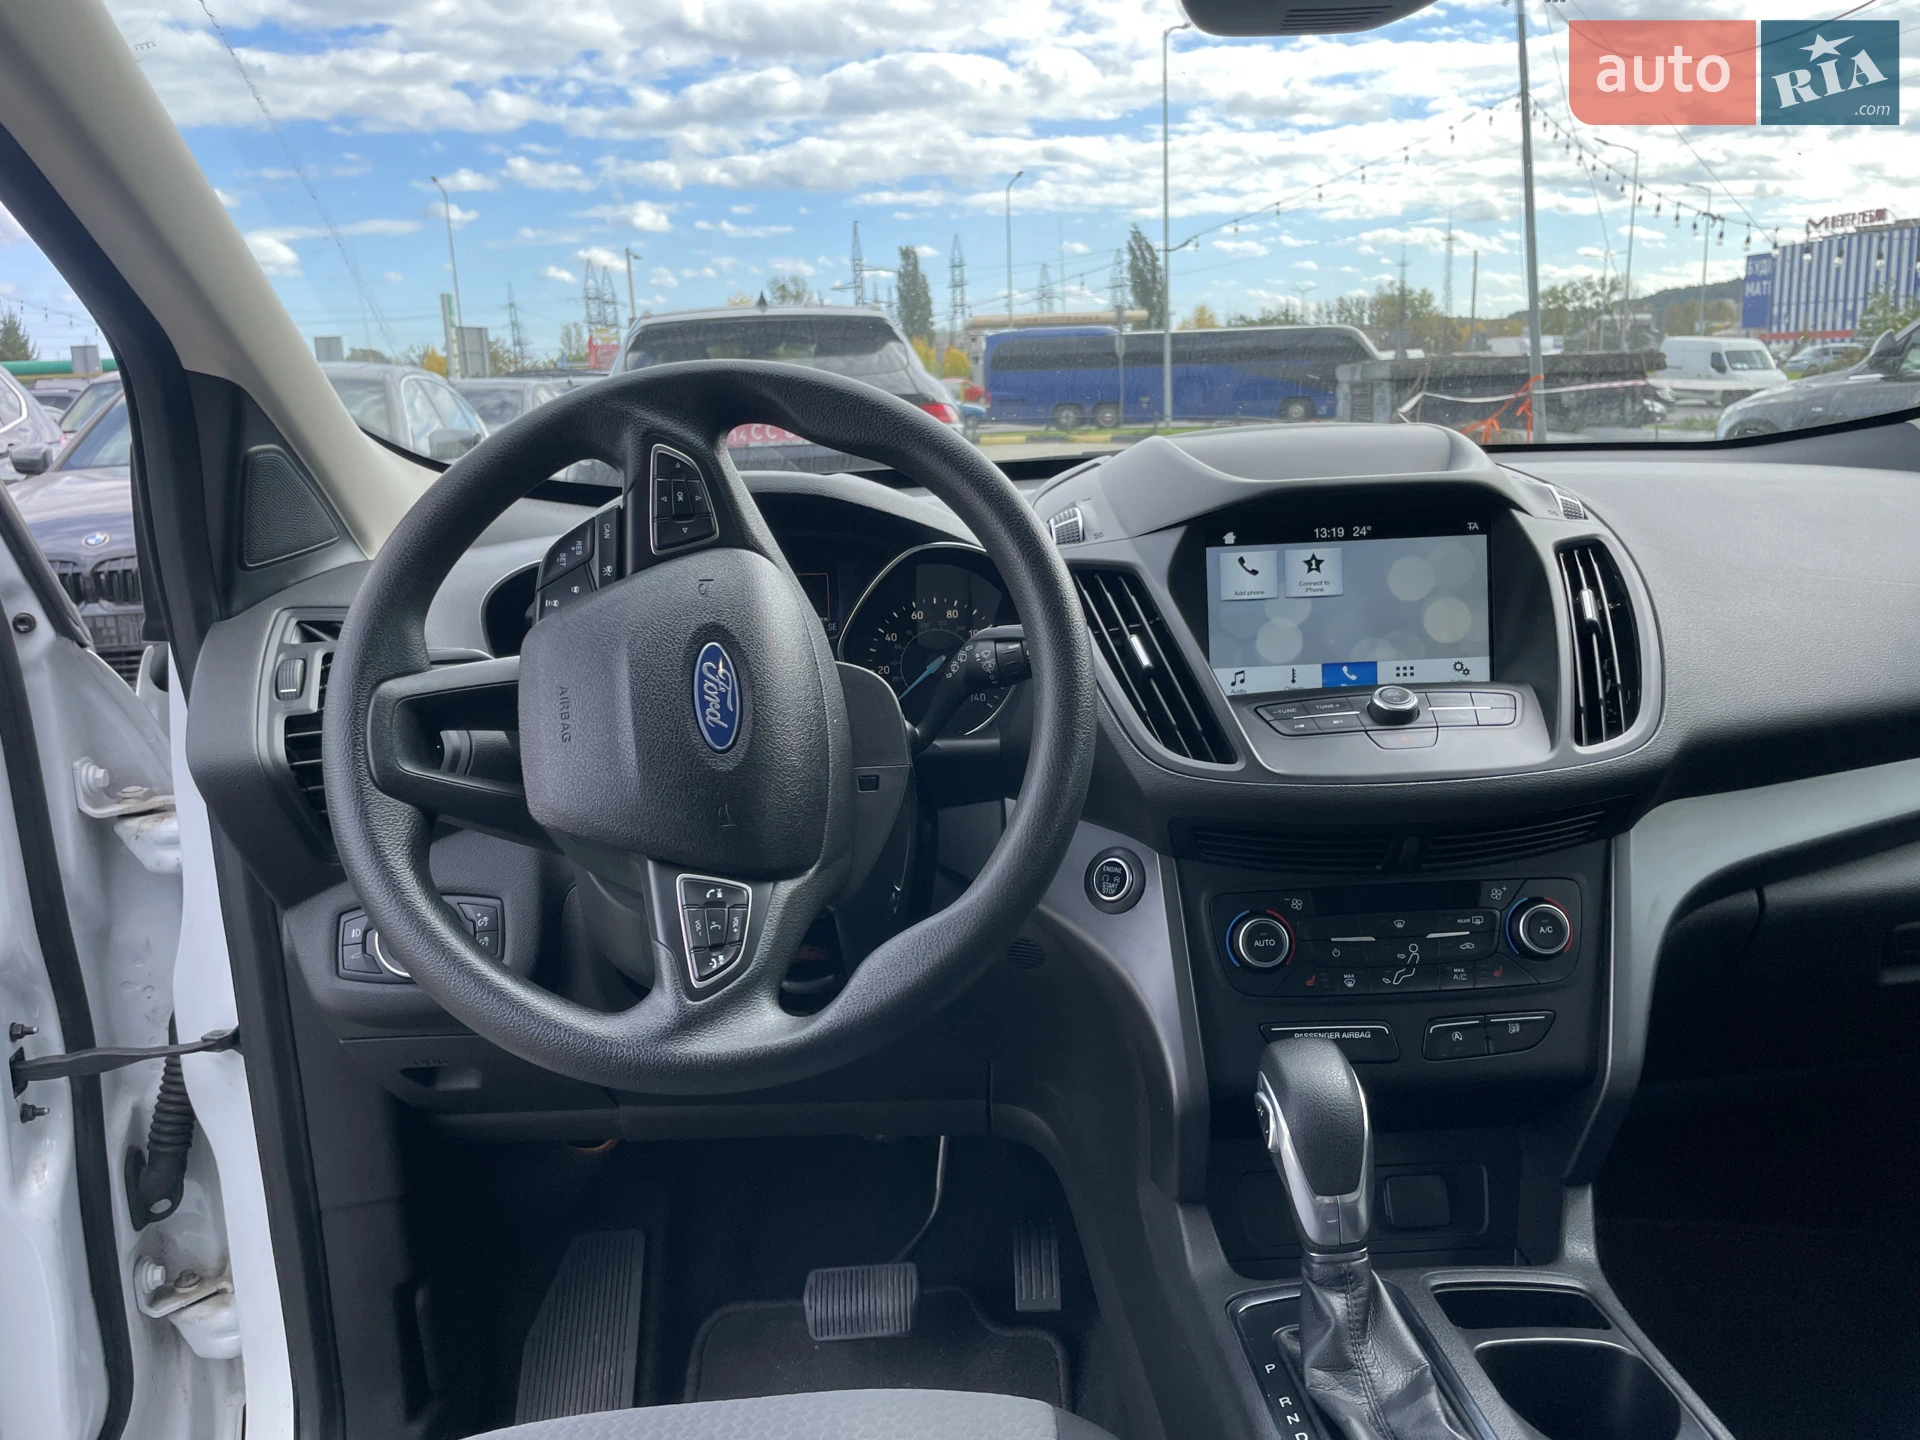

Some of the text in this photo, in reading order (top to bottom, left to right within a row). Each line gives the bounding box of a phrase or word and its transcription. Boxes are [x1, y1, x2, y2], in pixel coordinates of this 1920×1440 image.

[676, 491, 684, 502] OK
[603, 523, 611, 539] CAN
[1313, 525, 1372, 539] 13:19 24°
[575, 540, 583, 556] RES
[559, 552, 567, 567] SET
[1247, 589, 1265, 597] phone
[911, 610, 924, 620] 60
[946, 609, 959, 619] 80
[827, 622, 837, 631] SE
[885, 632, 898, 642] 40
[877, 665, 890, 675] 20
[702, 661, 734, 730] Ford
[970, 693, 986, 702] 140
[558, 686, 571, 743] AIRBAG
[1102, 865, 1122, 874] ENGINE
[1102, 881, 1118, 889] START
[1539, 926, 1553, 934] A/C
[1254, 939, 1276, 947] AUTO
[1453, 973, 1467, 981] A/C
[1341, 1031, 1371, 1039] AIRBAG
[1264, 1363, 1276, 1374] P
[1278, 1396, 1293, 1408] R
[1286, 1412, 1300, 1425] N
